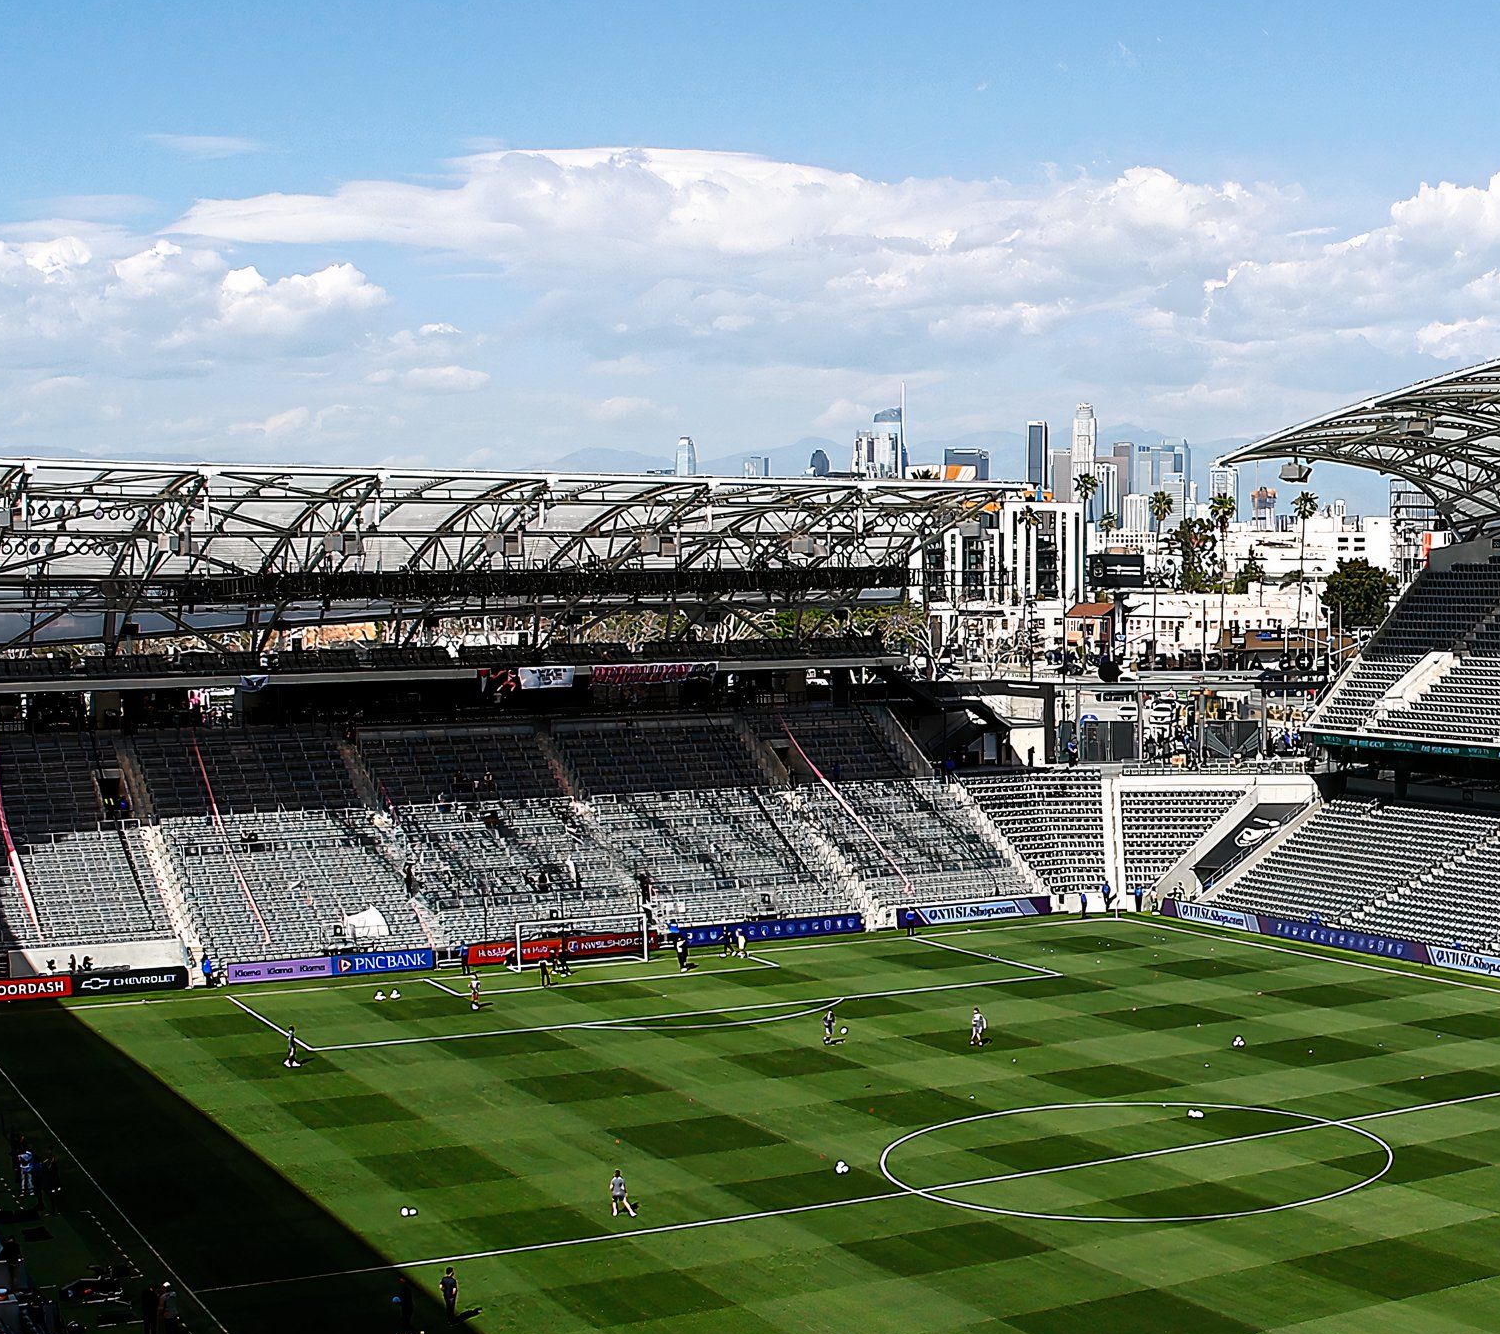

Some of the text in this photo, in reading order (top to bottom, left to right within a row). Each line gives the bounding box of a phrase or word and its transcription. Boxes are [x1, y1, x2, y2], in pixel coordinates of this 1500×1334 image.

[354, 953, 426, 970] PNC BANK
[113, 974, 177, 986] CHEVROLET
